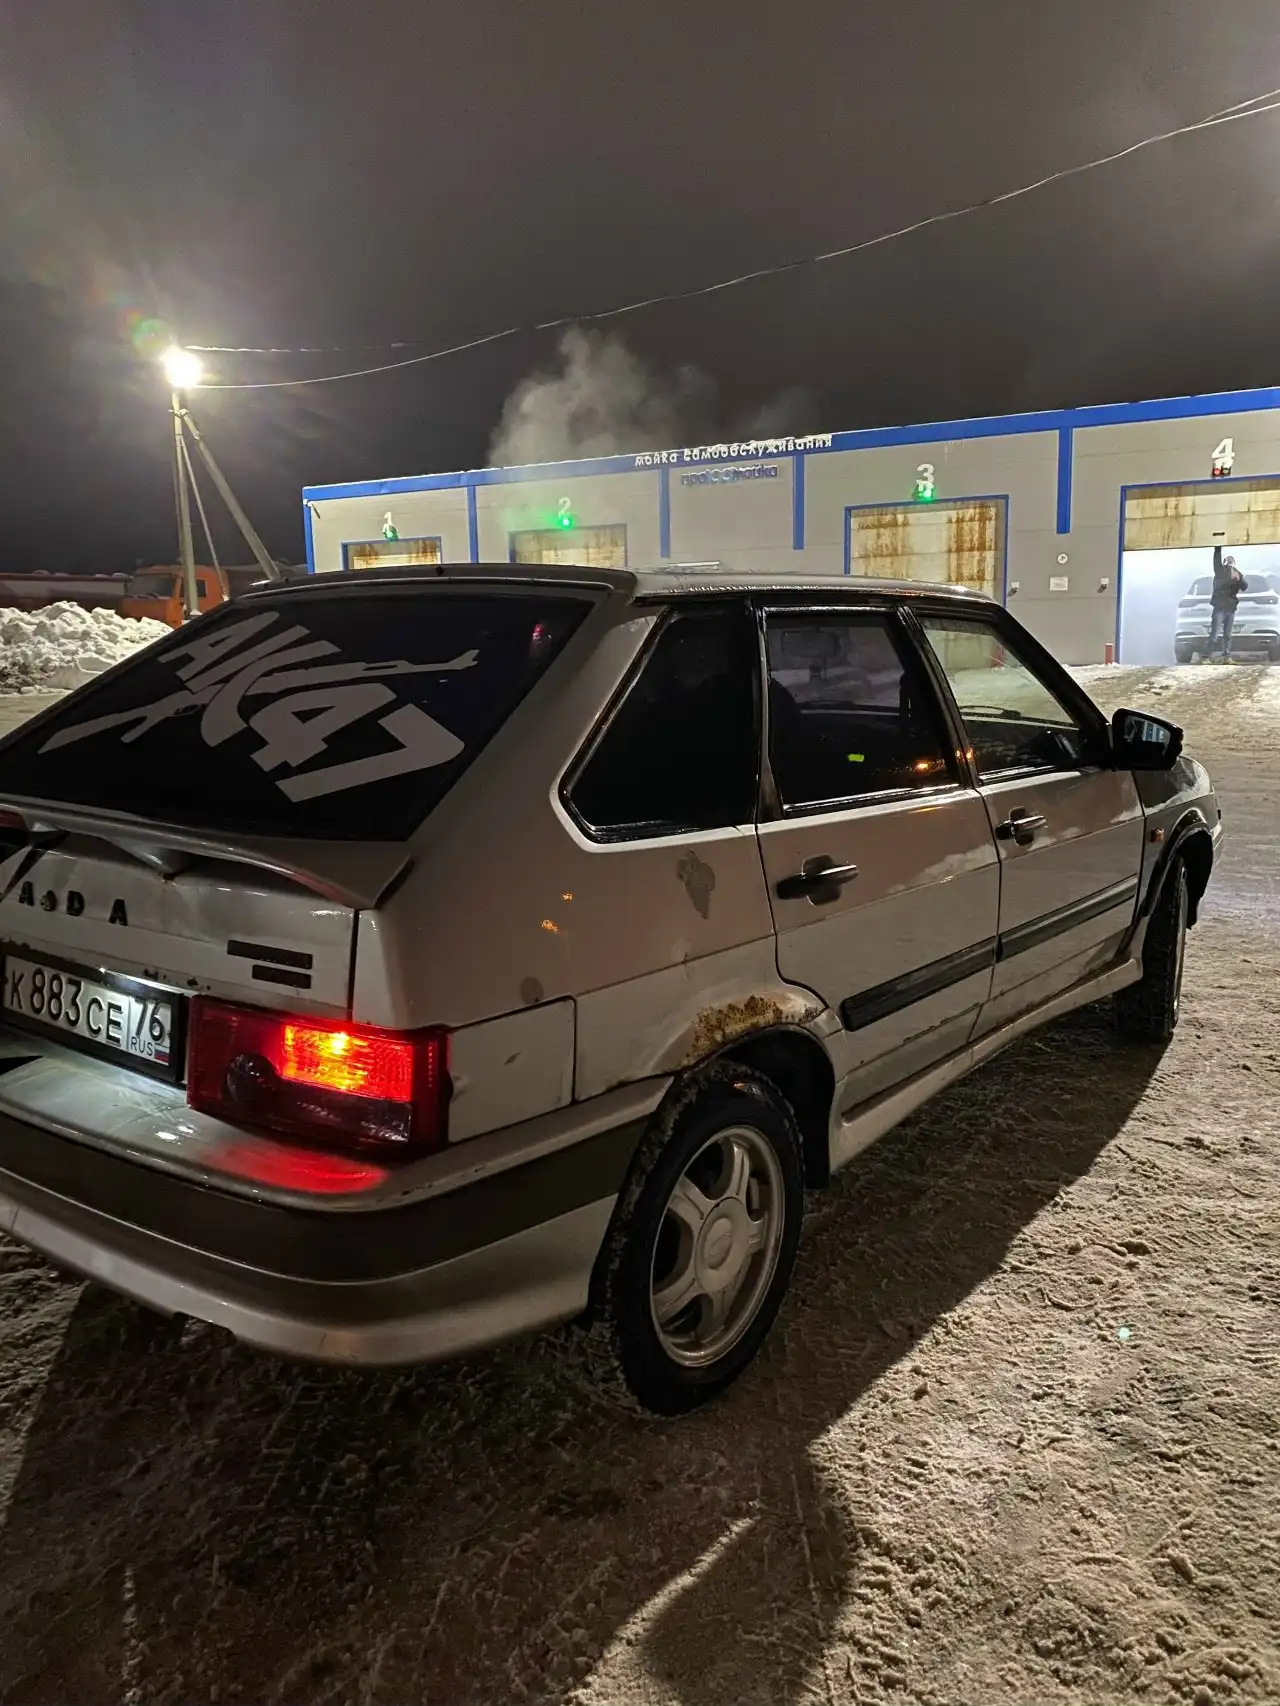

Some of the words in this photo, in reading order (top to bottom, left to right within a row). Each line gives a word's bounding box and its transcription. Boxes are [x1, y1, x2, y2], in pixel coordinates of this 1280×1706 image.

[1211, 437, 1236, 462] 4
[916, 463, 935, 488] 3
[133, 999, 167, 1042] 76
[130, 1036, 154, 1057] RUS
